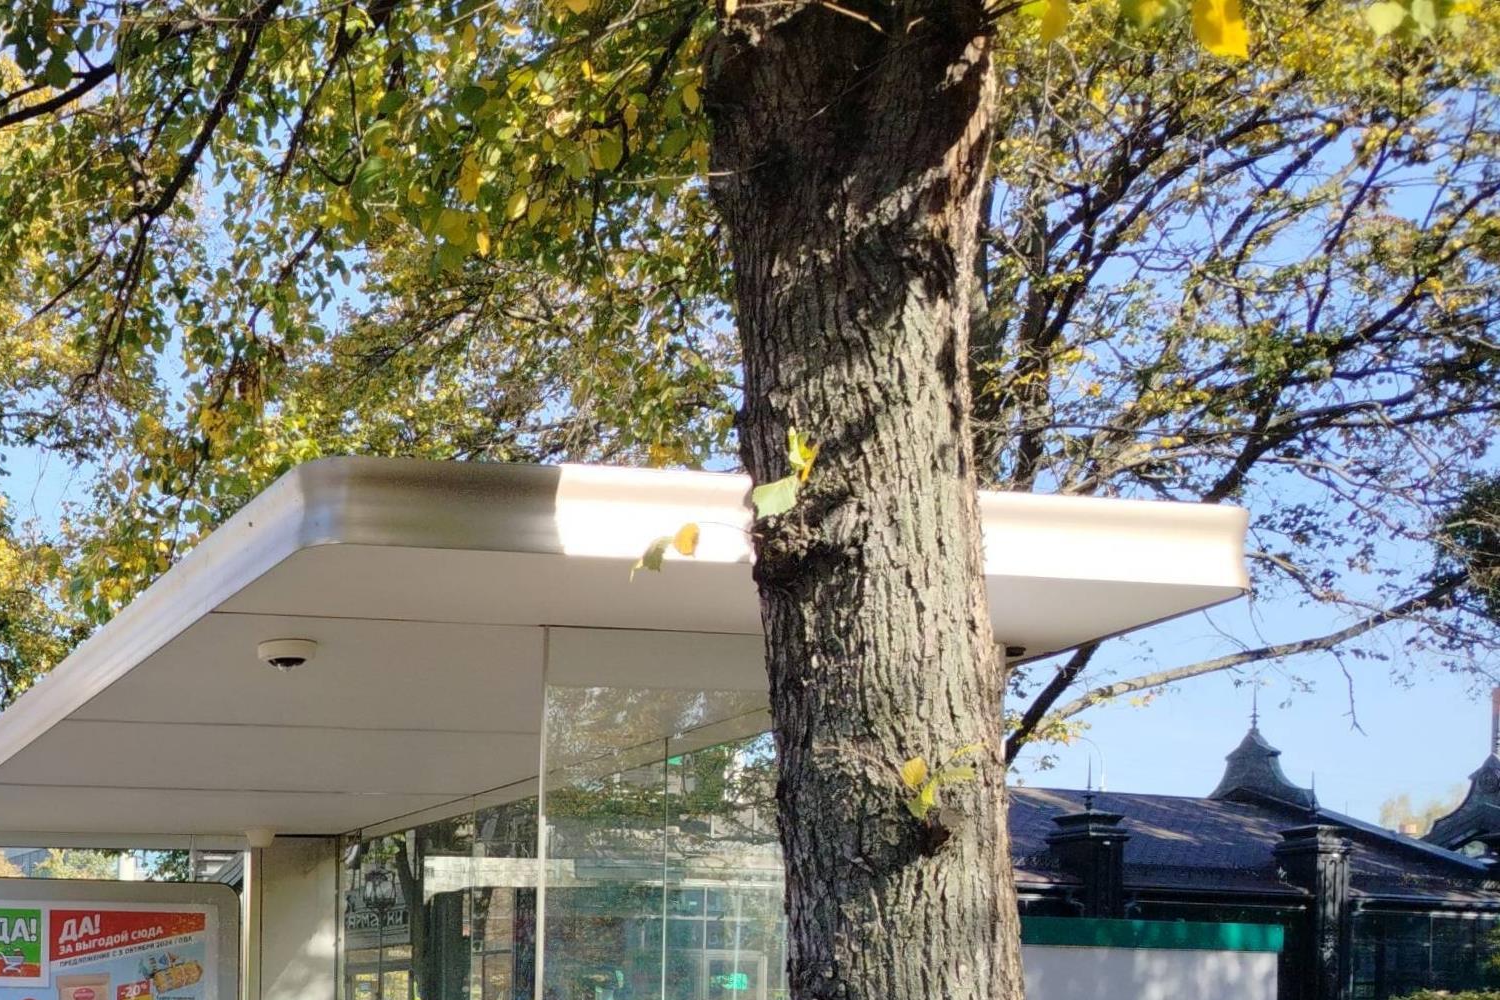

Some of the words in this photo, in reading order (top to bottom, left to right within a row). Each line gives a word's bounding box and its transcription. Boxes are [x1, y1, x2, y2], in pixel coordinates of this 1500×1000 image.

[58, 914, 101, 944] ДА!
[58, 944, 73, 955] ЗА
[75, 933, 129, 952] ВЫГОДОЙ
[131, 926, 164, 940] СЮДА
